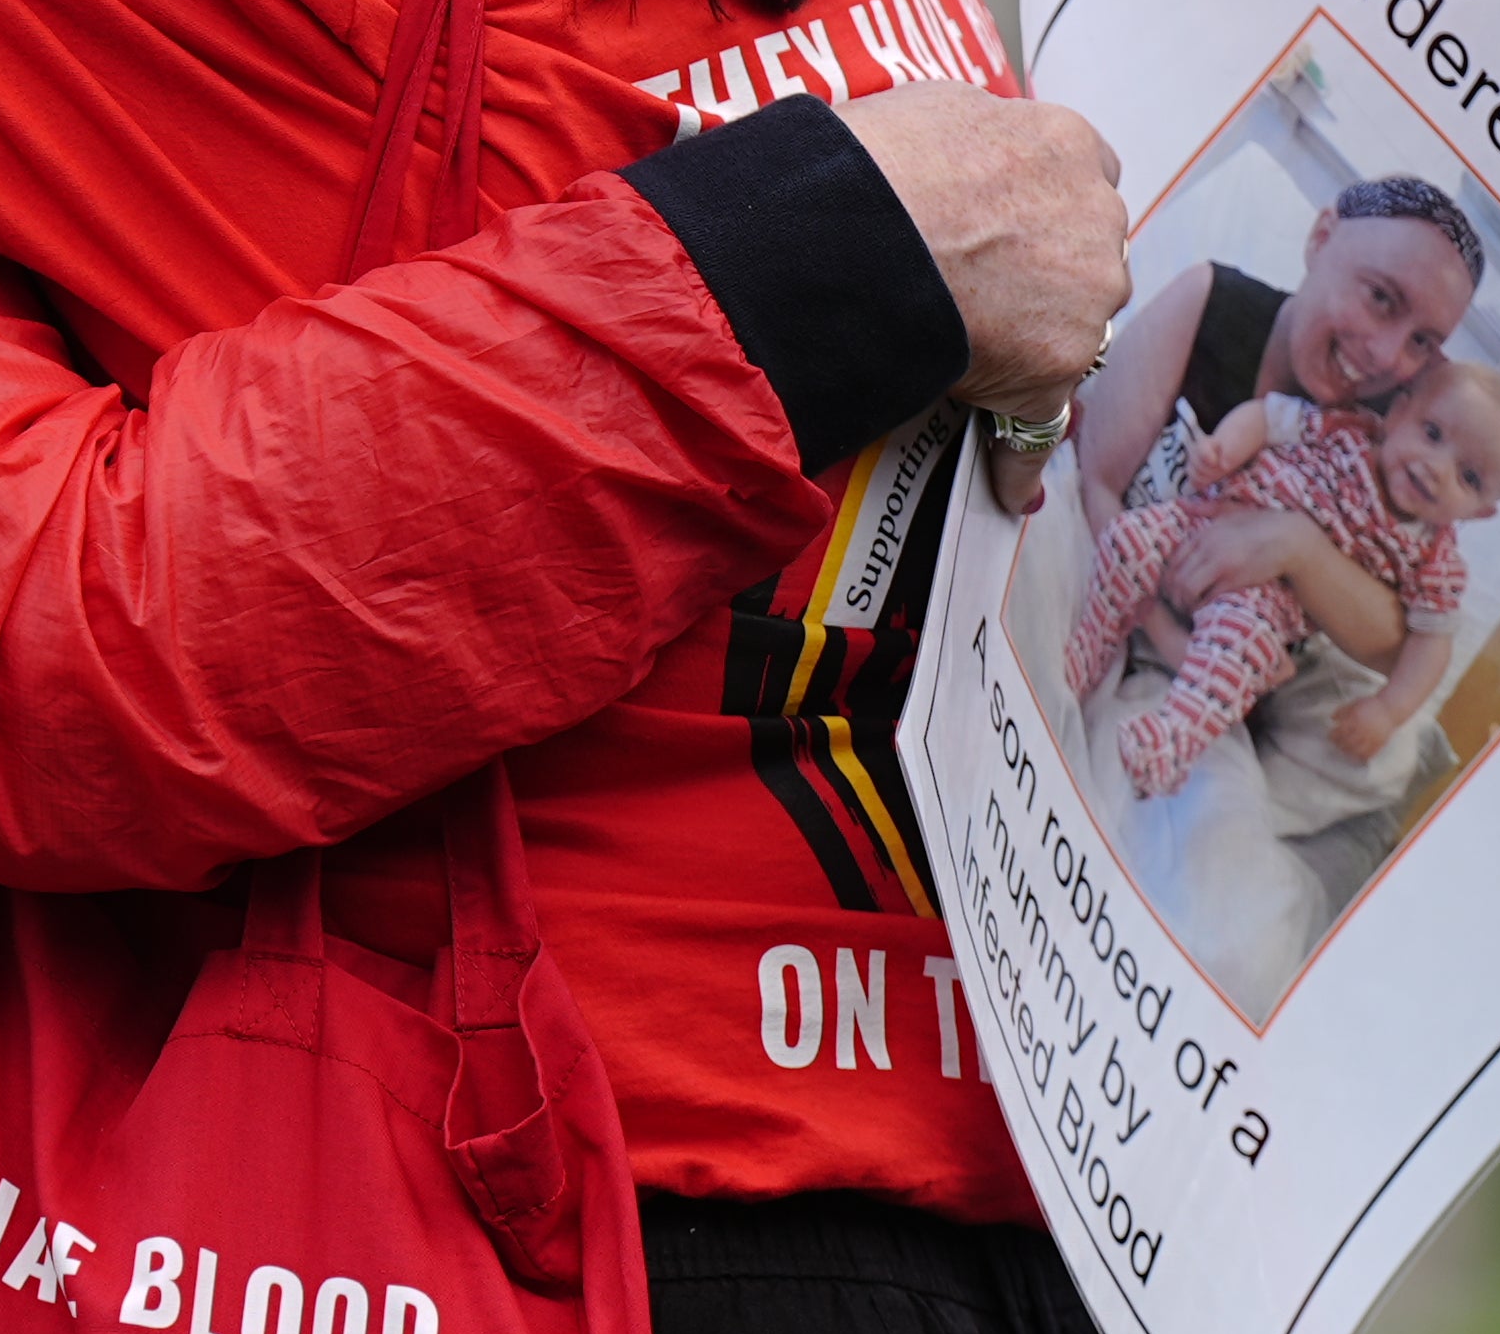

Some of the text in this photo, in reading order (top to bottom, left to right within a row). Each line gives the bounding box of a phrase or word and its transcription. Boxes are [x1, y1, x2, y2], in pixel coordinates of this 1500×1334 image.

[846, 409, 950, 612] Supporting
[758, 944, 893, 1070] ON
[961, 817, 1163, 1285] Infected Blood
[972, 615, 1270, 1166] A son robbed of a
[985, 788, 1151, 1145] mummy by
